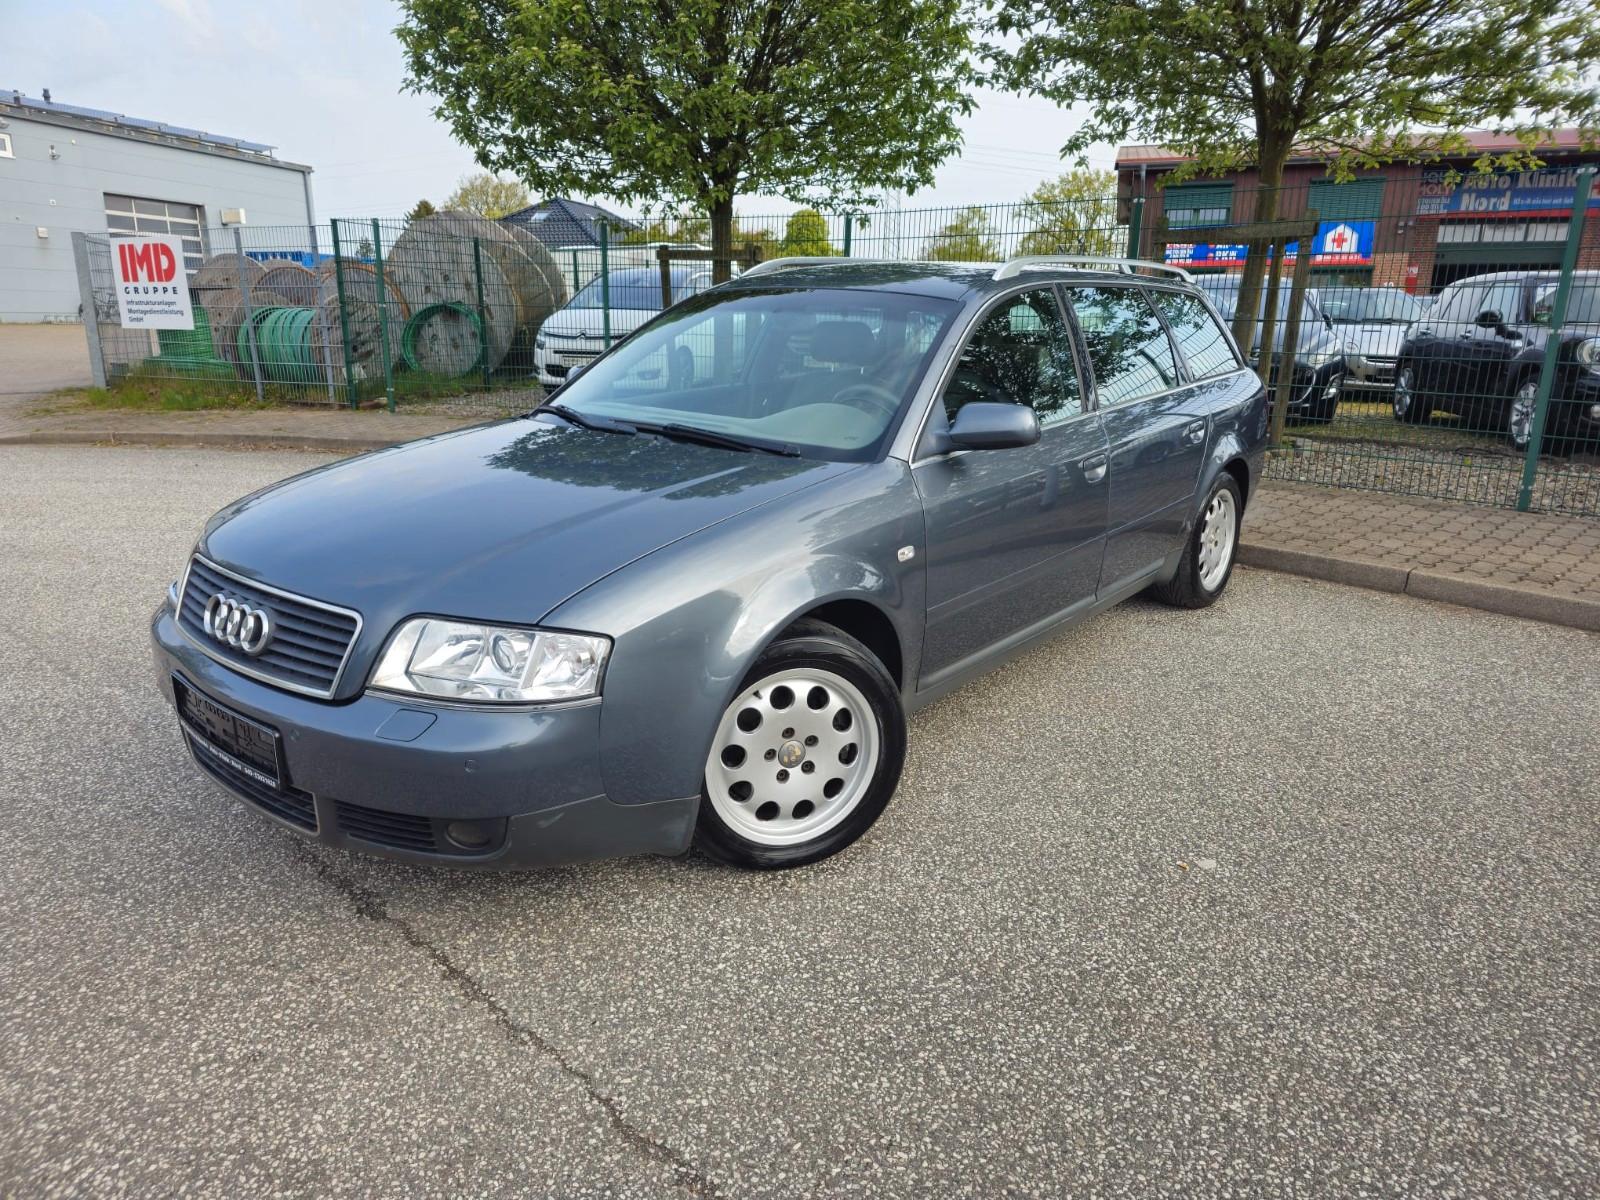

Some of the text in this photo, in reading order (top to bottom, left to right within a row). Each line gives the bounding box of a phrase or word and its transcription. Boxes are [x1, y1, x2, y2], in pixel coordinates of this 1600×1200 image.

[1516, 170, 1579, 188] Klinik
[1460, 191, 1511, 211] Nord
[118, 243, 176, 282] IMD
[124, 286, 178, 295] GRUPPE
